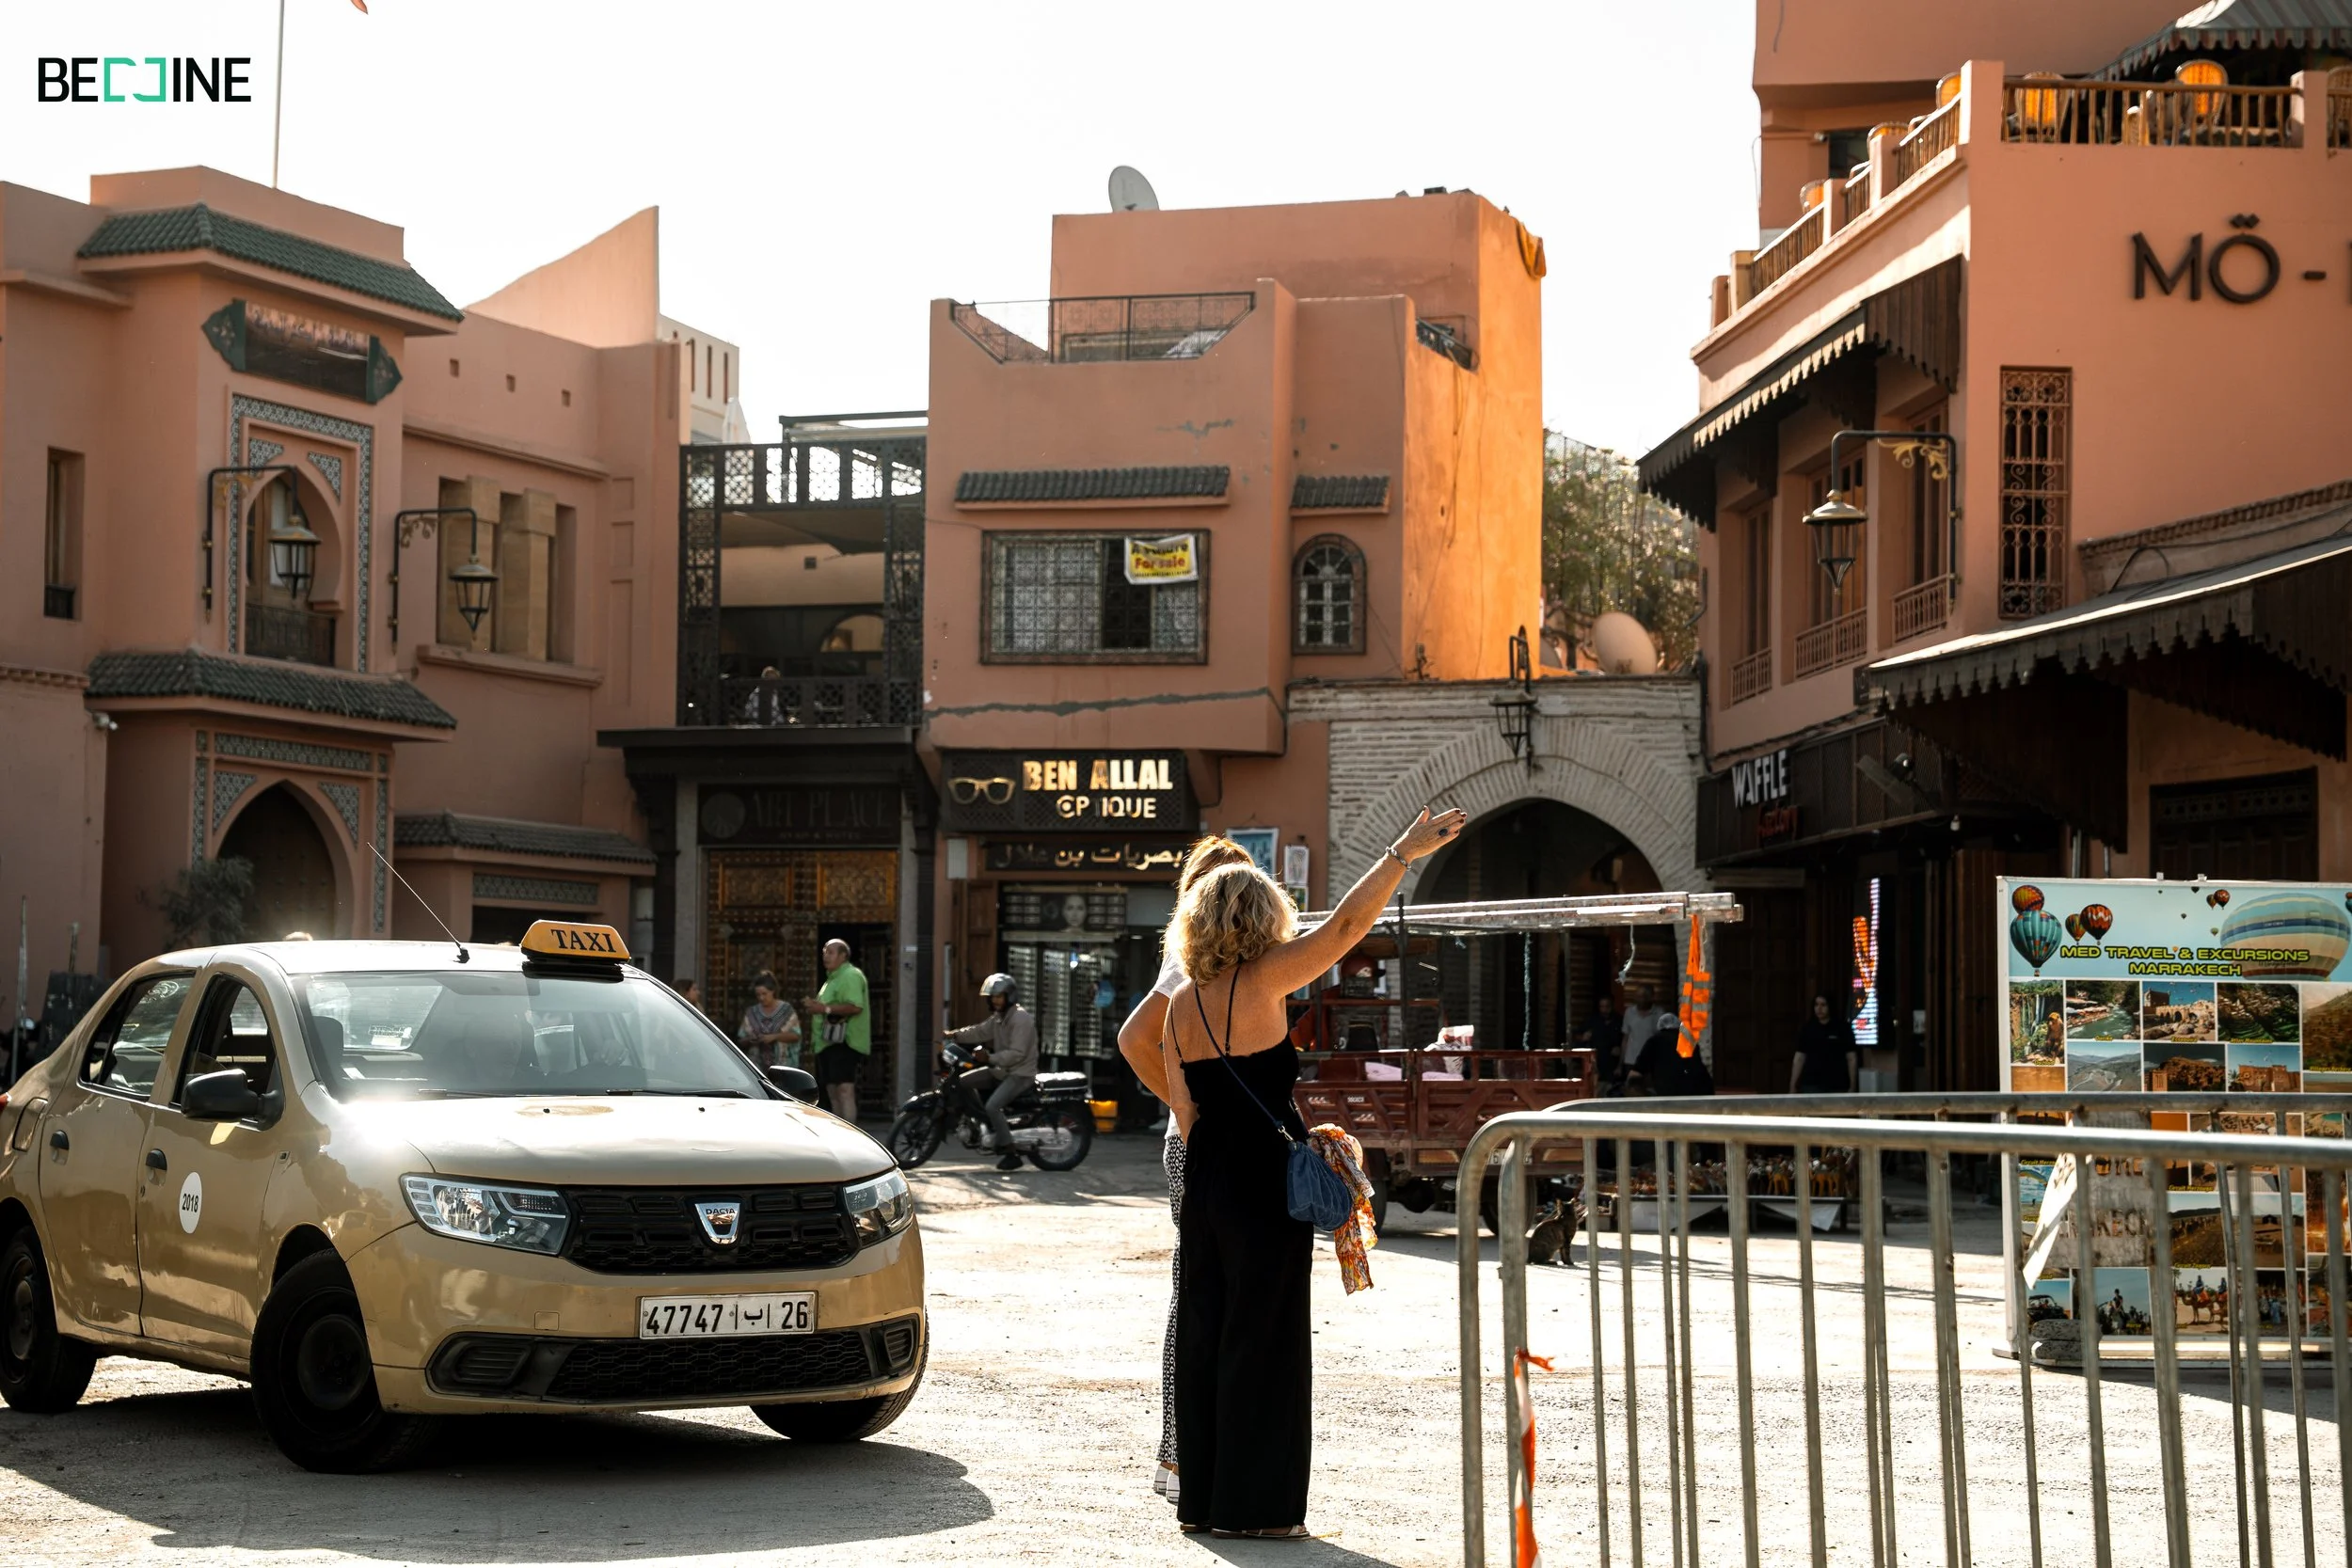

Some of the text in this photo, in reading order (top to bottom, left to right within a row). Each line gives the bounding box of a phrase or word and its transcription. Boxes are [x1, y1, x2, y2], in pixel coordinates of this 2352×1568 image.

[1135, 557, 1154, 570] For
[1023, 759, 1174, 791] BEN ALLAL
[1731, 749, 1787, 809] WAFFLE
[550, 928, 616, 953] TAXI
[2060, 945, 2310, 962] MED TRAVEL & EXCURSIONS
[2129, 962, 2243, 976] MARRAKECH
[182, 1193, 199, 1213] 2018
[645, 1305, 723, 1335] 47747
[781, 1301, 808, 1330] 26
